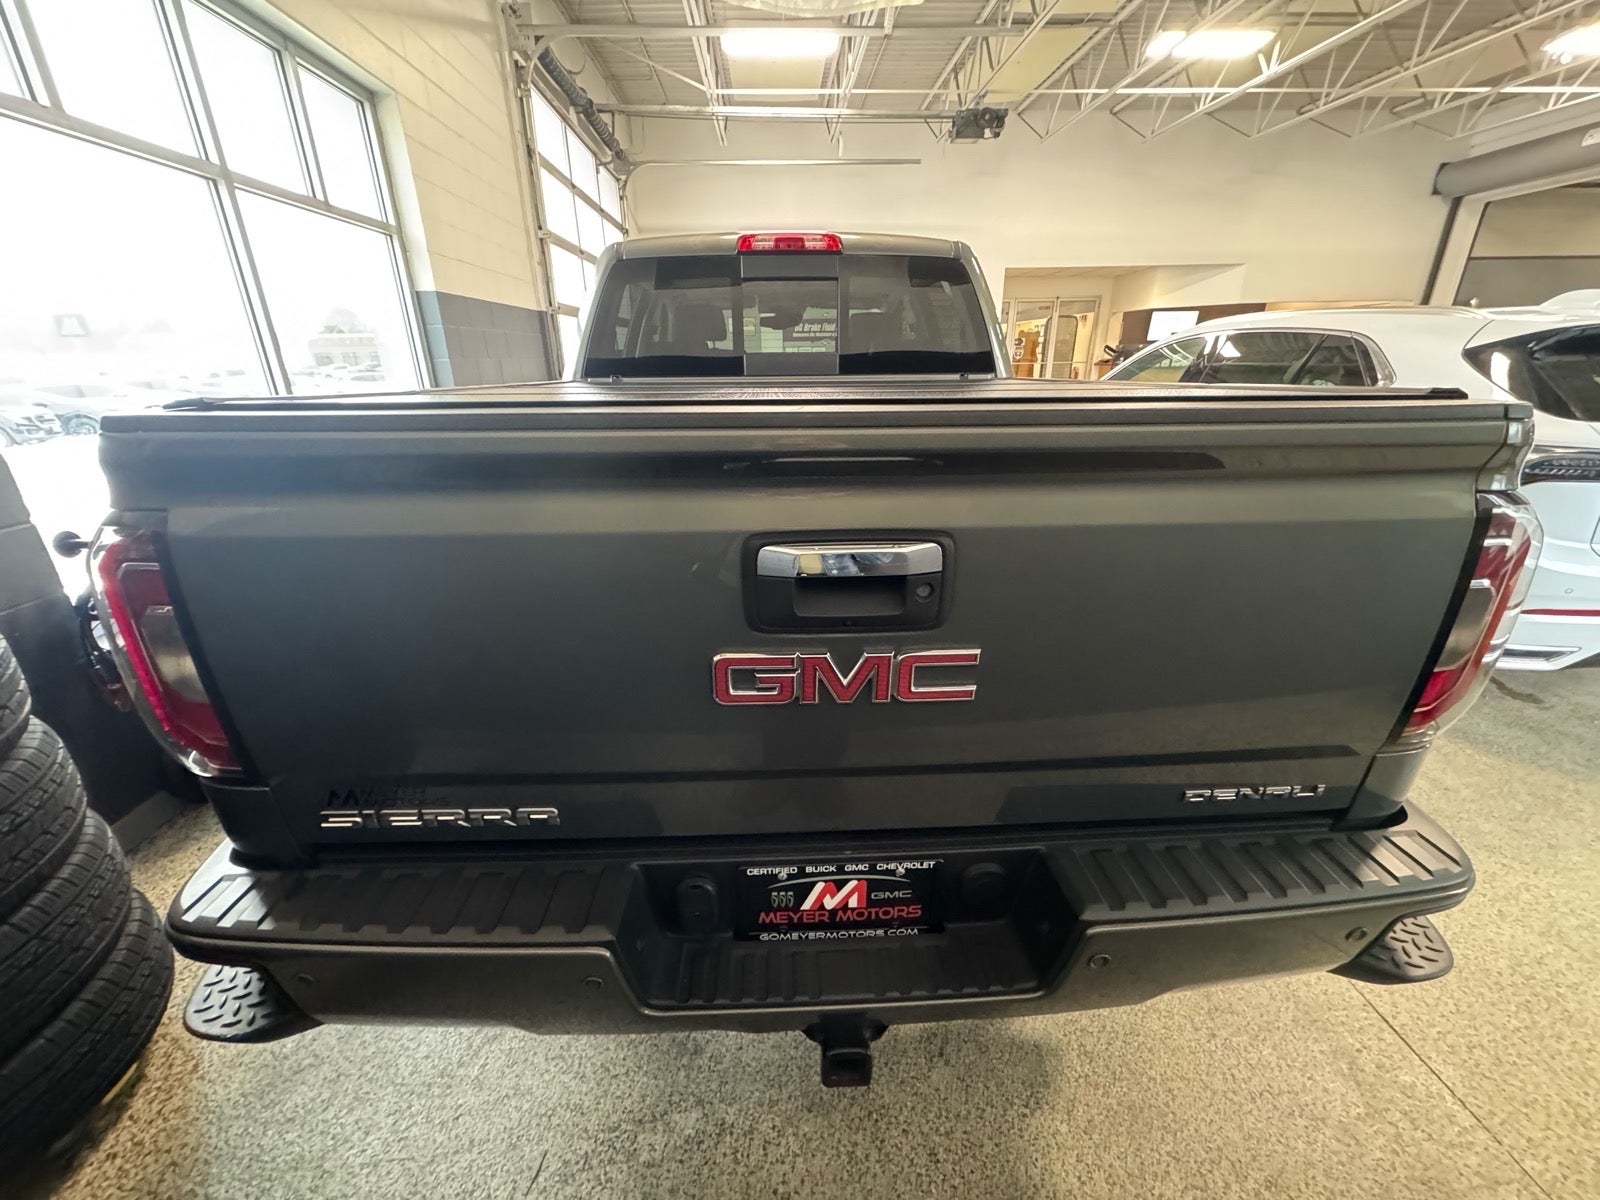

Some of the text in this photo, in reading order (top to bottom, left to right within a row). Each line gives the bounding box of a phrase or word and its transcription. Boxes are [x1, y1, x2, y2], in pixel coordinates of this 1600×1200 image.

[713, 649, 981, 705] GMC
[1184, 784, 1326, 802] DENALI
[320, 807, 560, 828] SIERRA
[746, 861, 936, 876] CERTIFIED BUICK GMC CHEVROLET
[871, 889, 913, 900] GMC
[758, 904, 922, 924] MEYER MOTORS
[759, 928, 919, 941] GOMEYERMOTORSCOM
